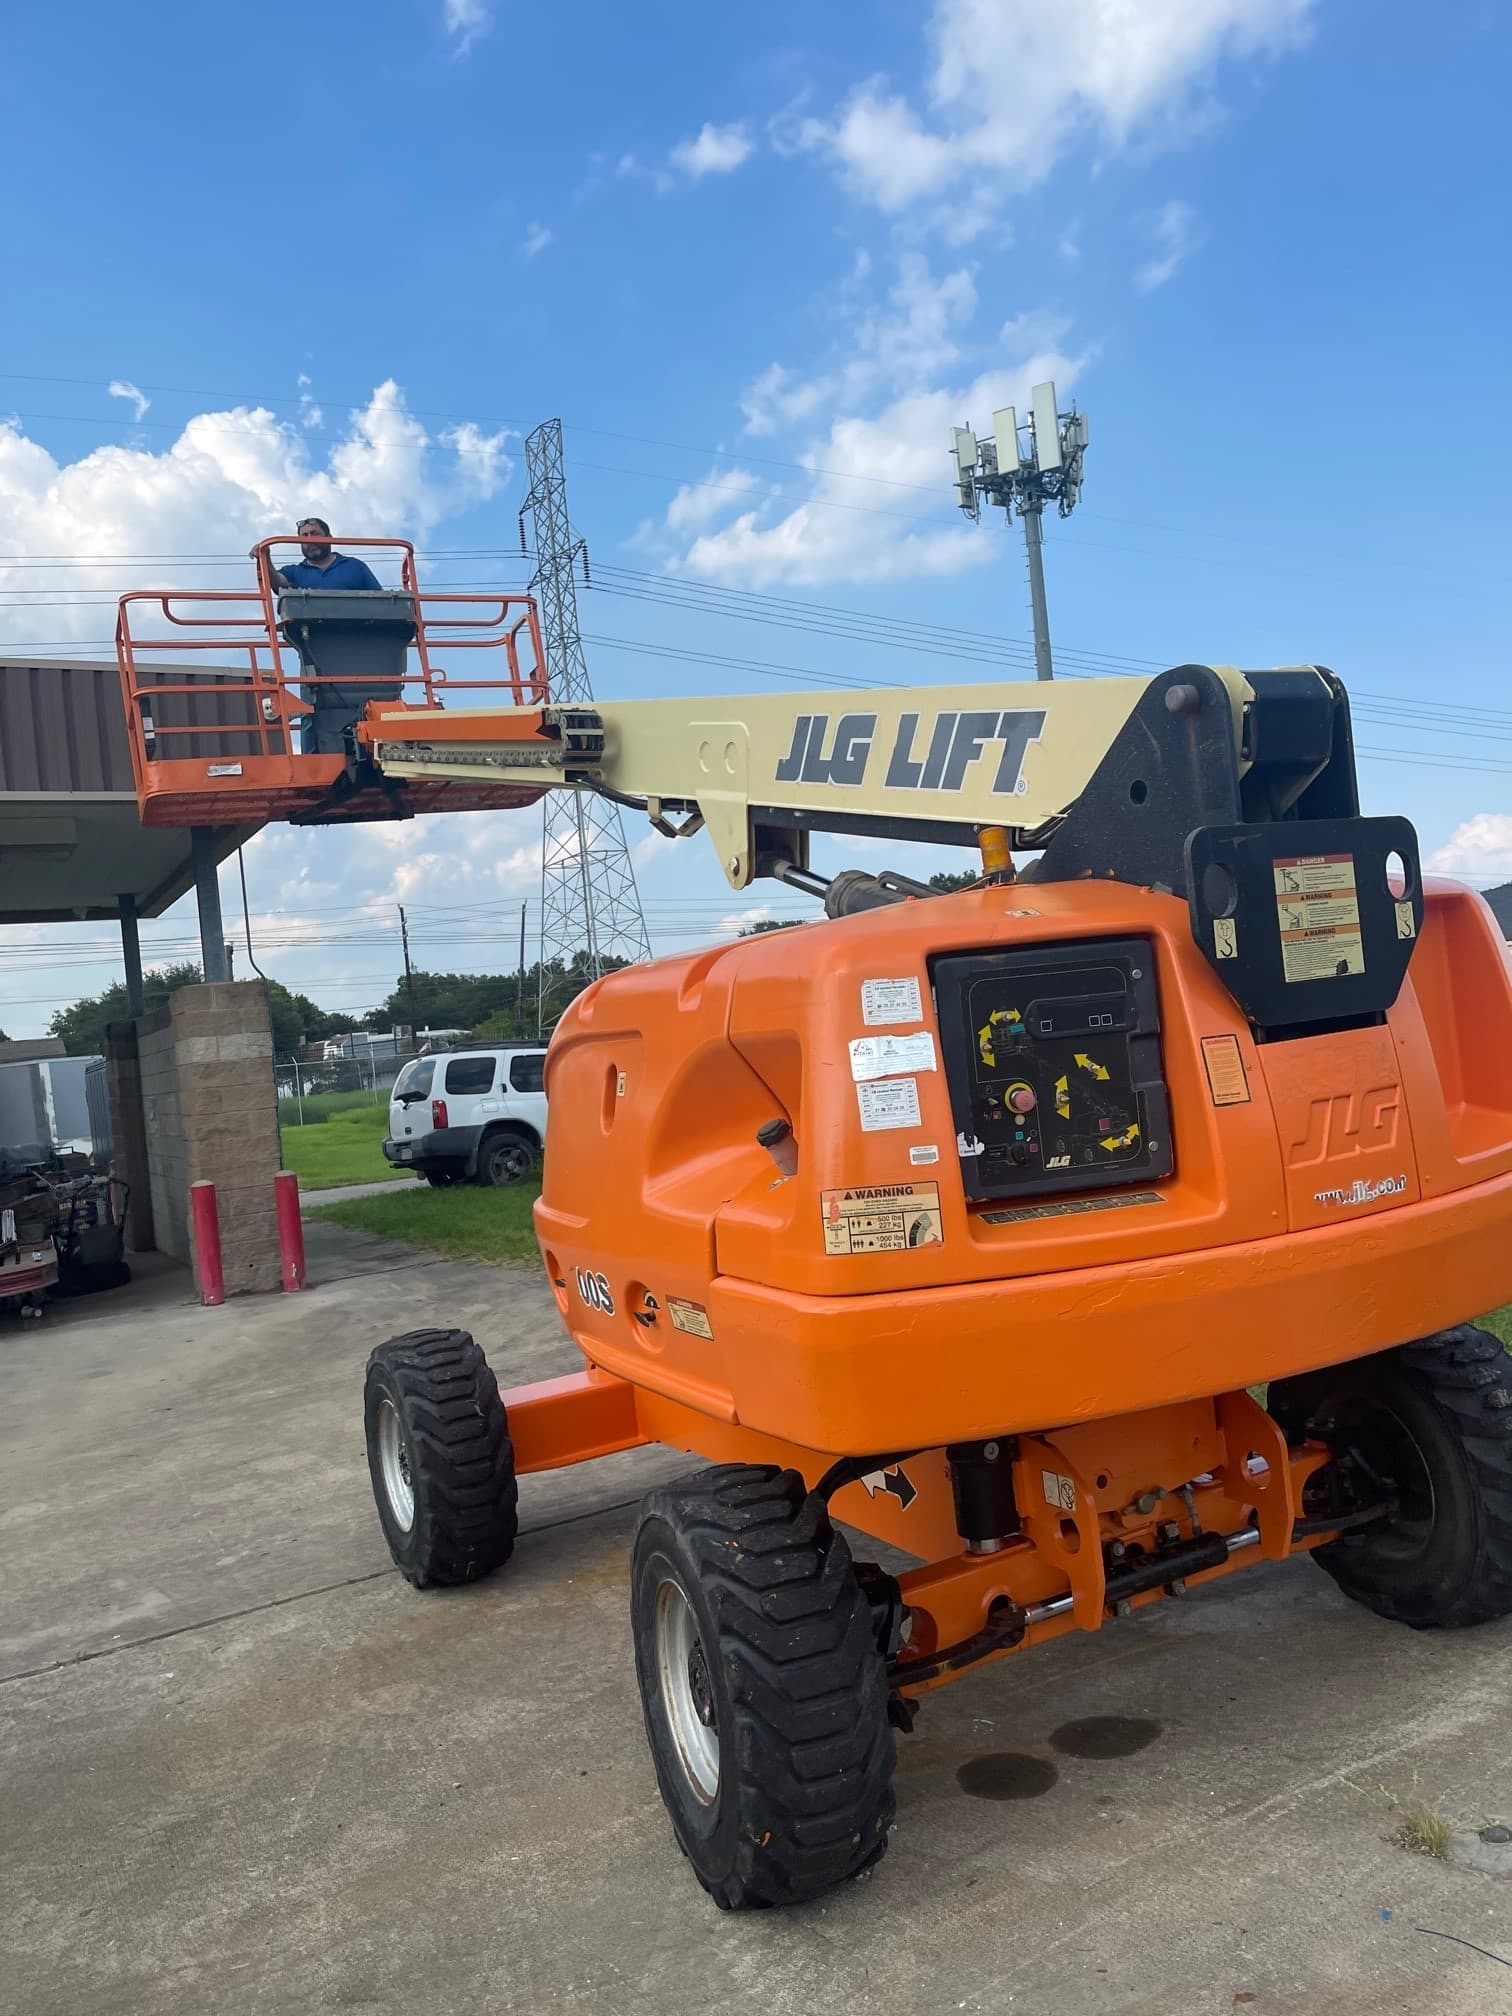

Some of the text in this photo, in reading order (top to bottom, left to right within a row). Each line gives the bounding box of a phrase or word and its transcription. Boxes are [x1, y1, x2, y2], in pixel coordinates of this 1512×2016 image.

[774, 709, 1048, 794] JLG LIFT
[1305, 892, 1333, 900] WARNING
[1309, 927, 1336, 936] WARNING
[1287, 1083, 1400, 1169] JLG
[1046, 1155, 1072, 1169] JLG
[855, 1186, 914, 1200] WARNING
